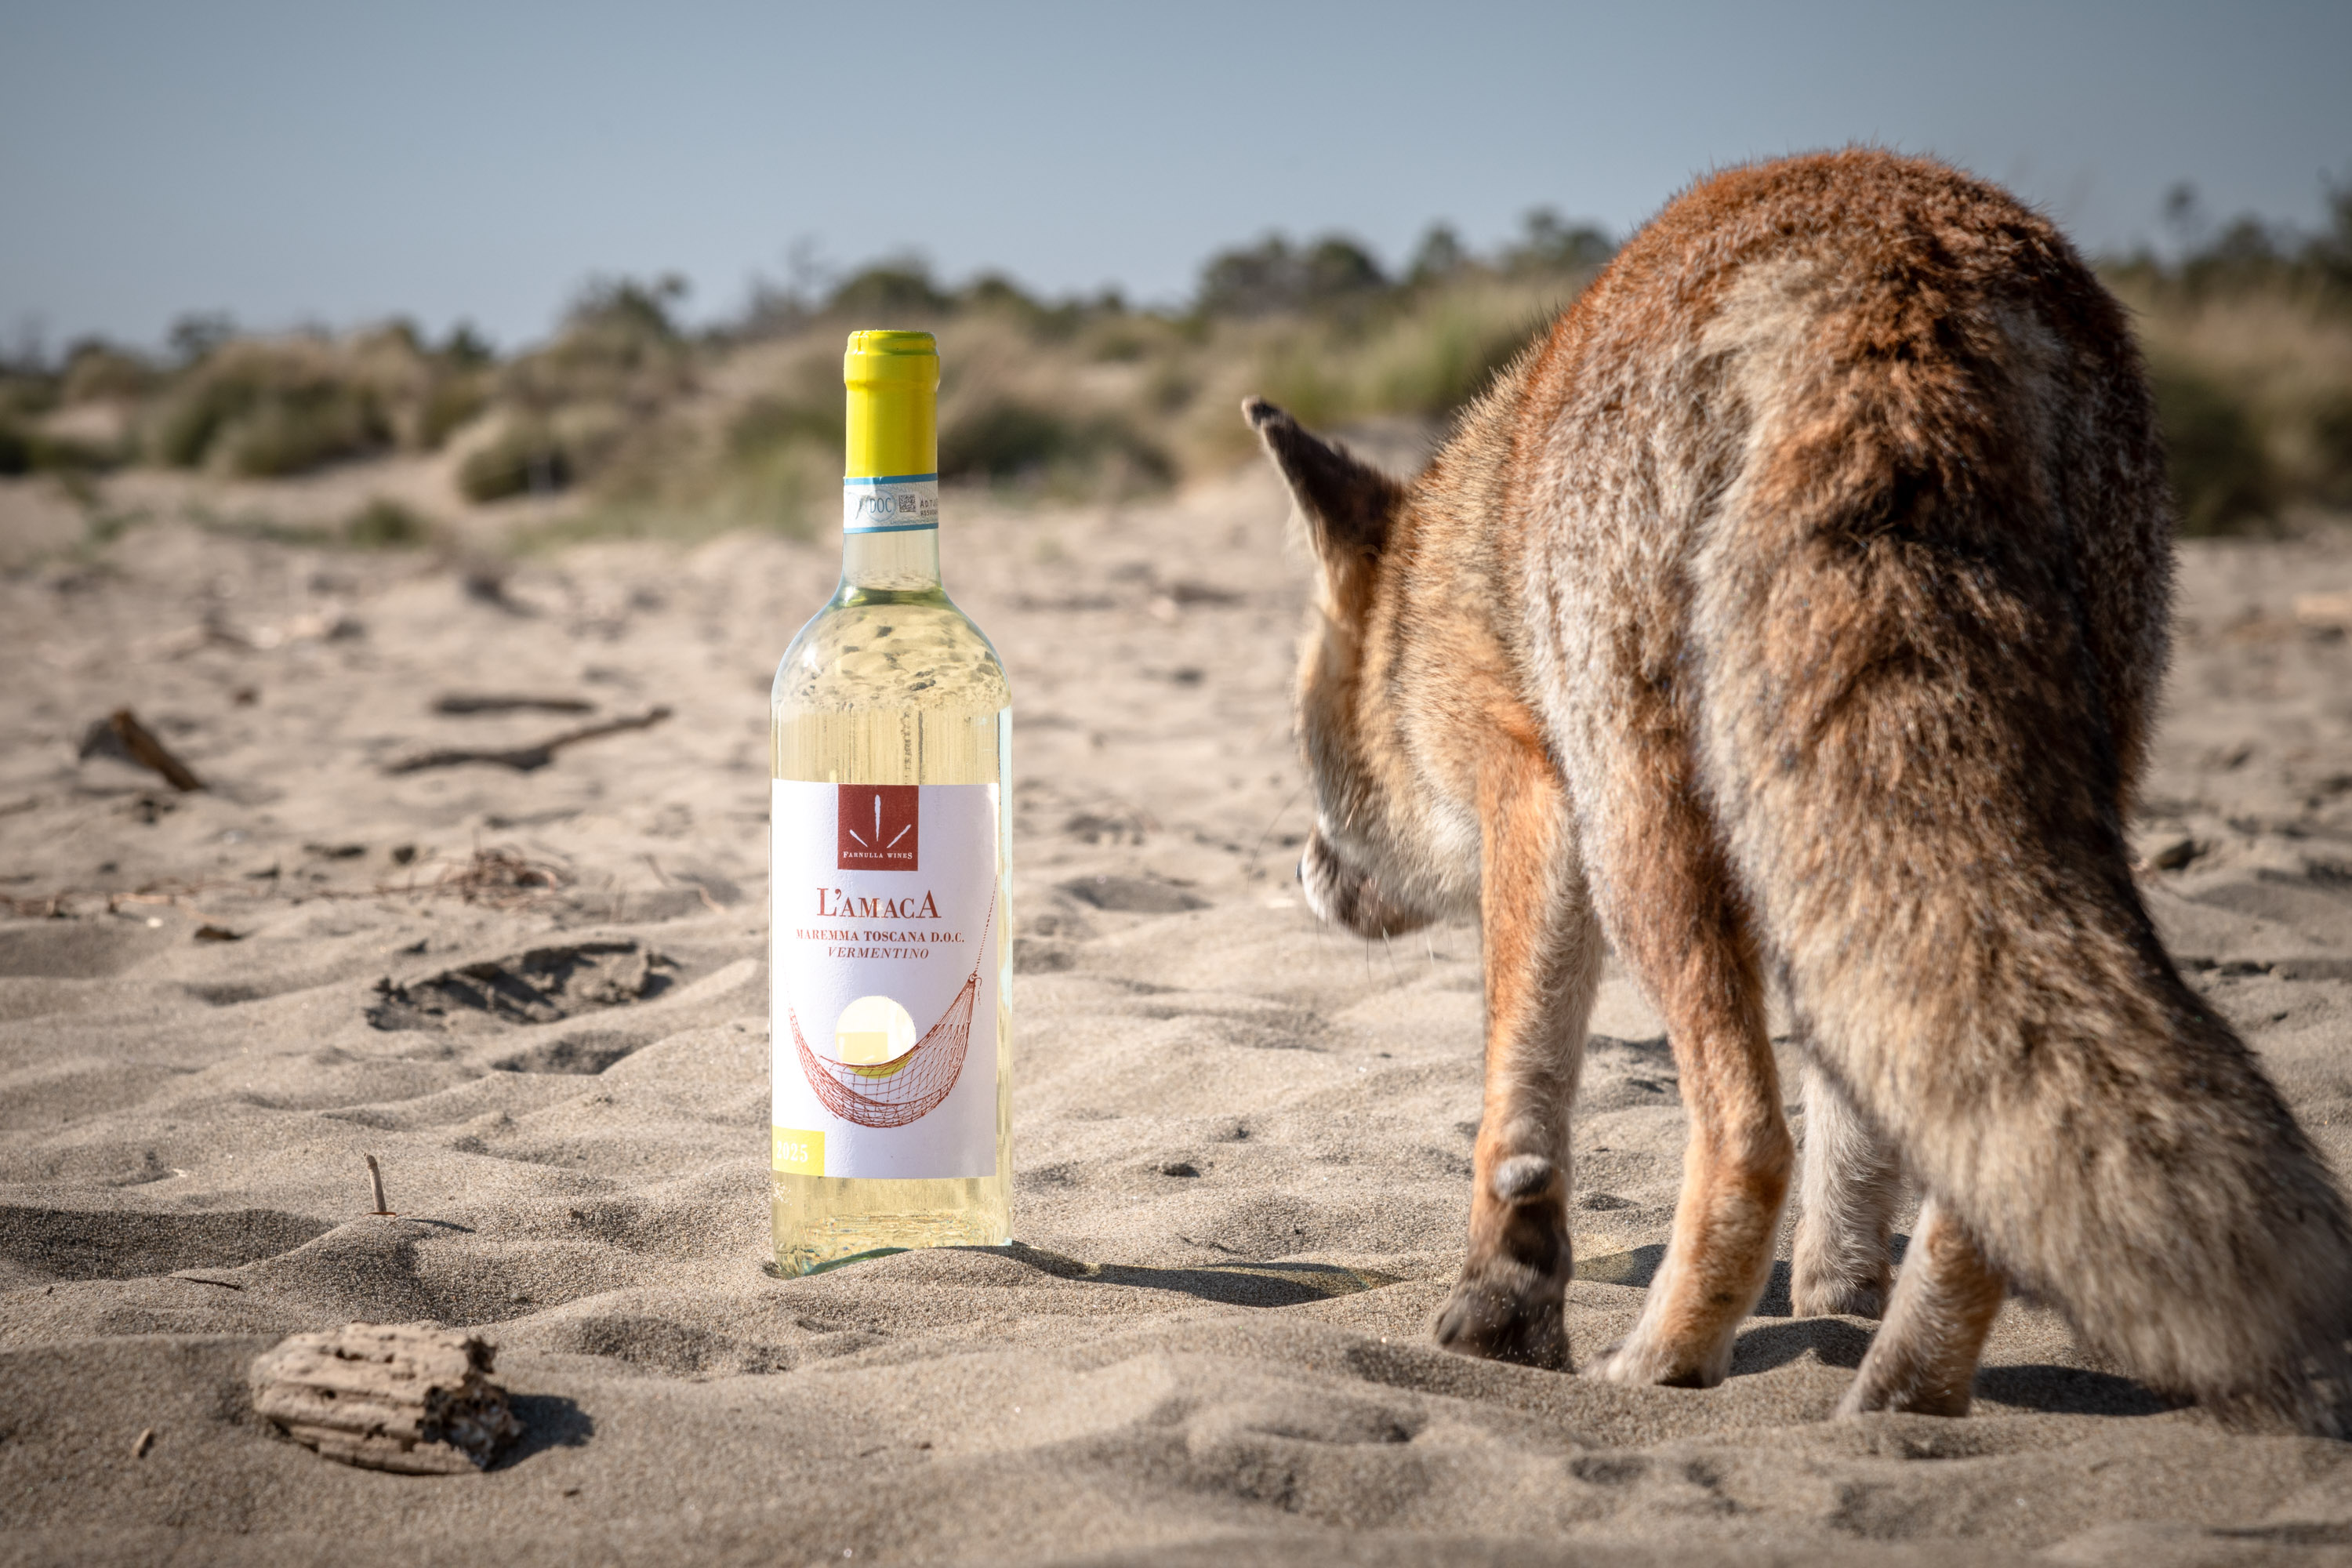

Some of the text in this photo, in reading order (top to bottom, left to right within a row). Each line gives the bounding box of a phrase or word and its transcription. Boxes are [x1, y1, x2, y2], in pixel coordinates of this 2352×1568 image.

[869, 497, 892, 514] DOC
[816, 887, 942, 919] L'AMACA
[796, 928, 965, 943] MAREMMA TOSCANA D.O.C.
[828, 946, 929, 960] VERMENTINO
[776, 1141, 808, 1163] 2025
